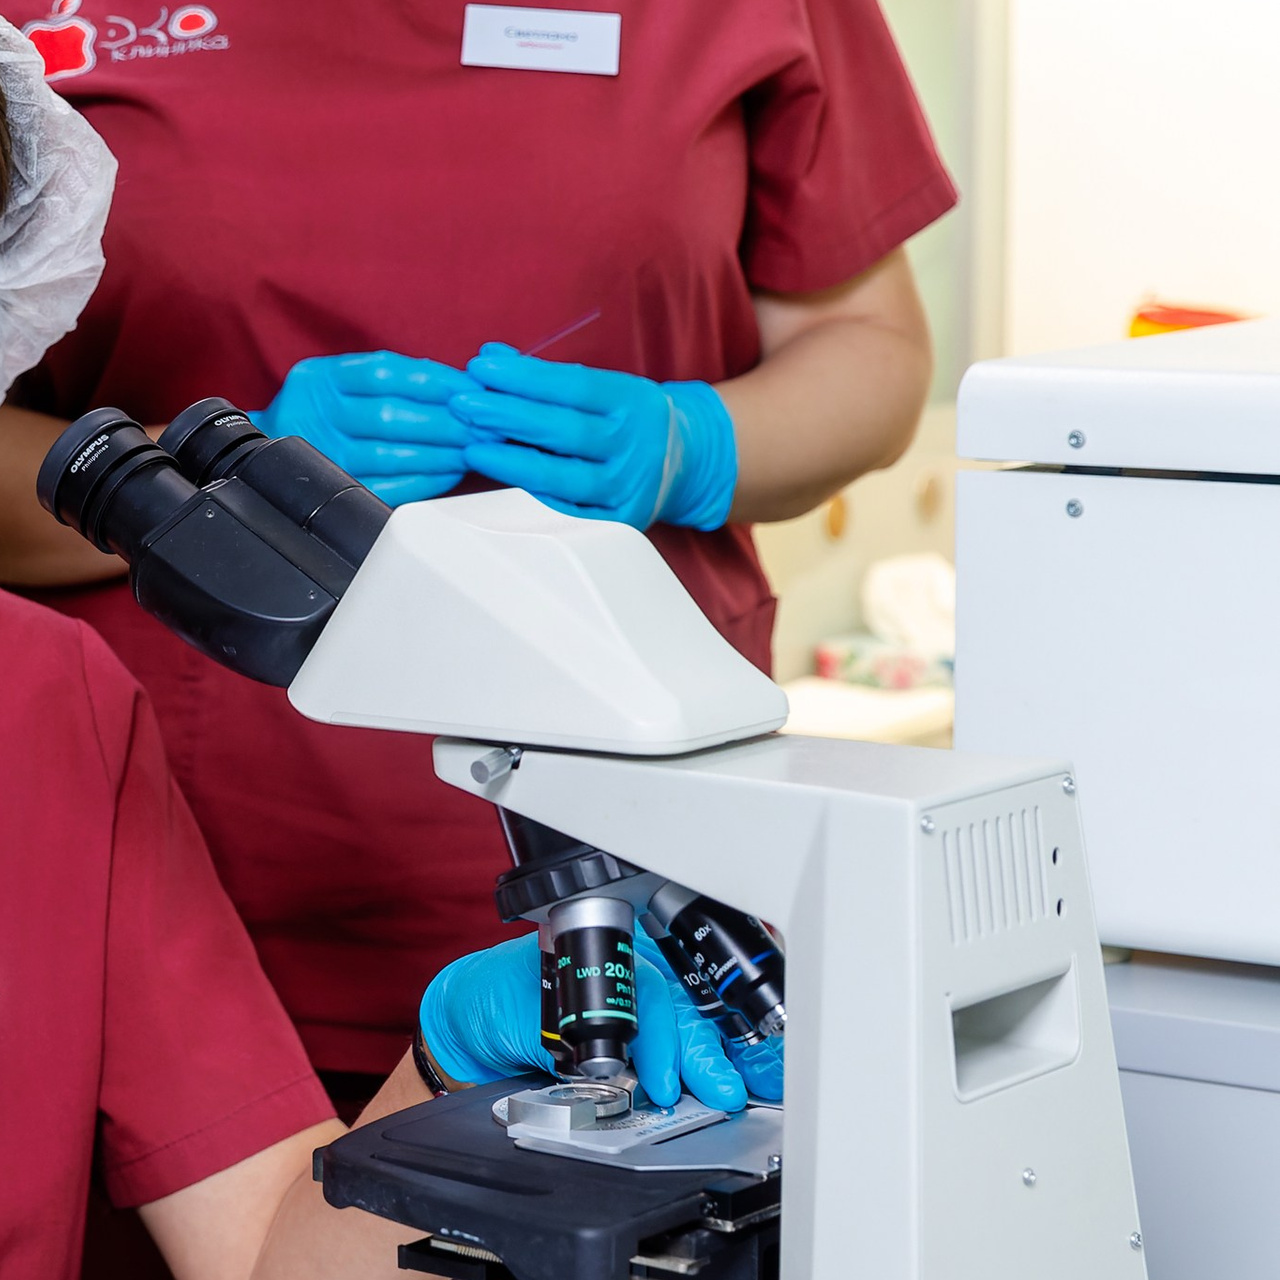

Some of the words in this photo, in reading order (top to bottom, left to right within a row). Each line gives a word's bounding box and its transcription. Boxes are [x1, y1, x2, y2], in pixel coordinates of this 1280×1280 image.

[70, 434, 109, 474] OLYMPUS
[81, 444, 109, 472] Philippines
[694, 924, 712, 941] 60x
[576, 966, 601, 979] LWD
